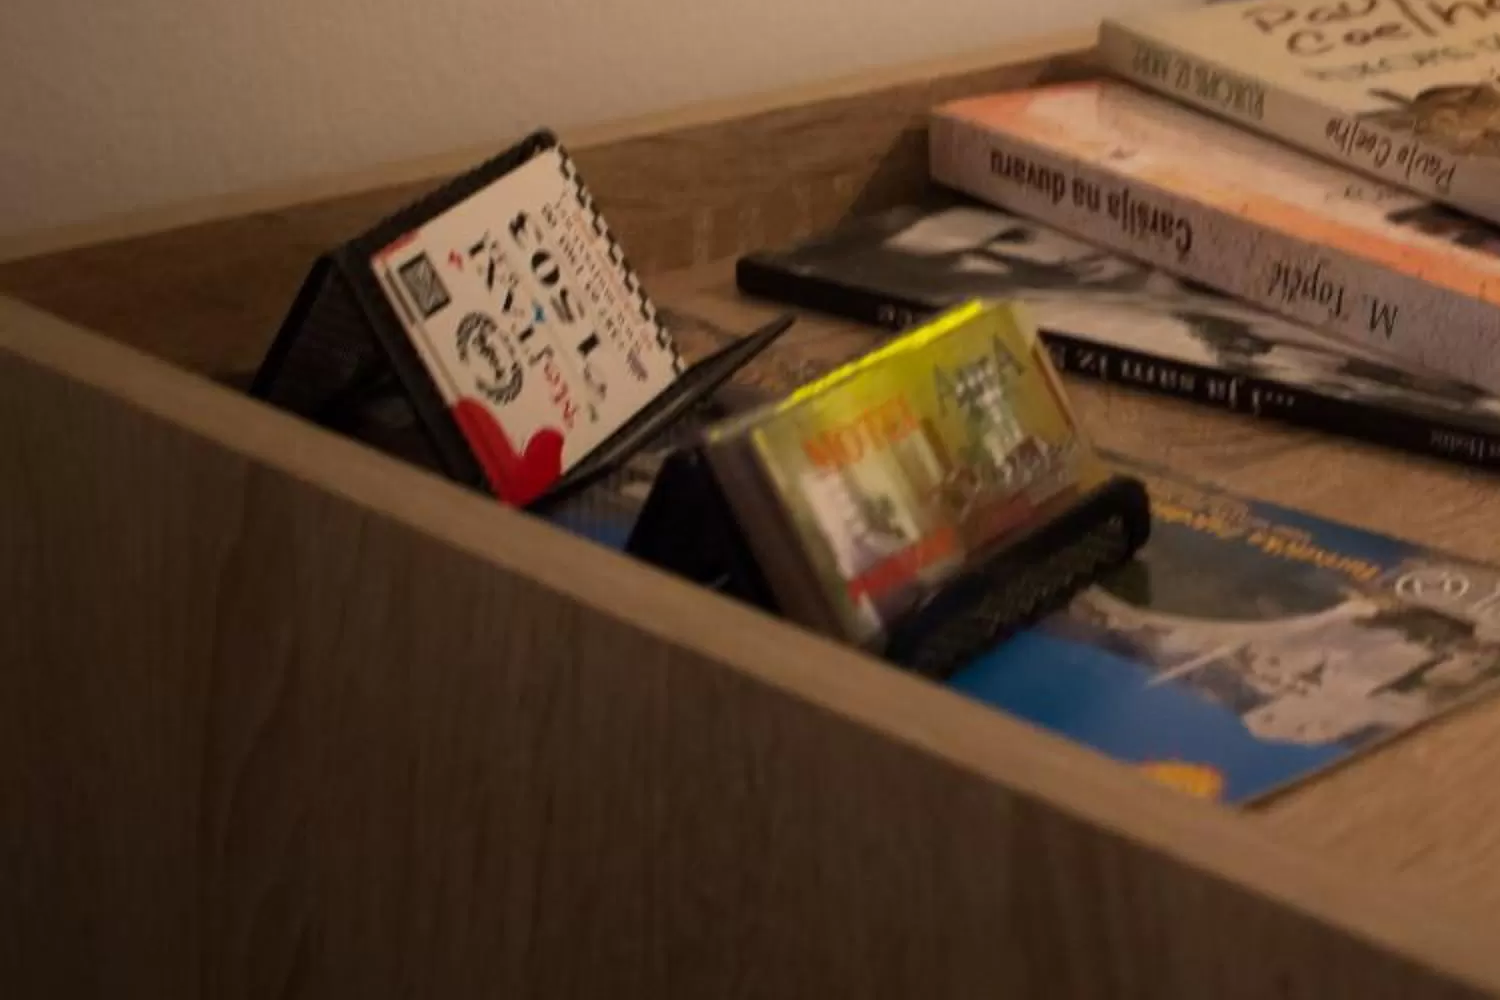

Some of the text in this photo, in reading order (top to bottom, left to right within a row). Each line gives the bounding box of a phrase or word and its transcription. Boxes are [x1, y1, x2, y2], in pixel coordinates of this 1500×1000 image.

[1324, 116, 1394, 168] Coelho
[988, 150, 1066, 204] duvaru
[1072, 175, 1101, 214] na
[1396, 145, 1458, 195] Paulo
